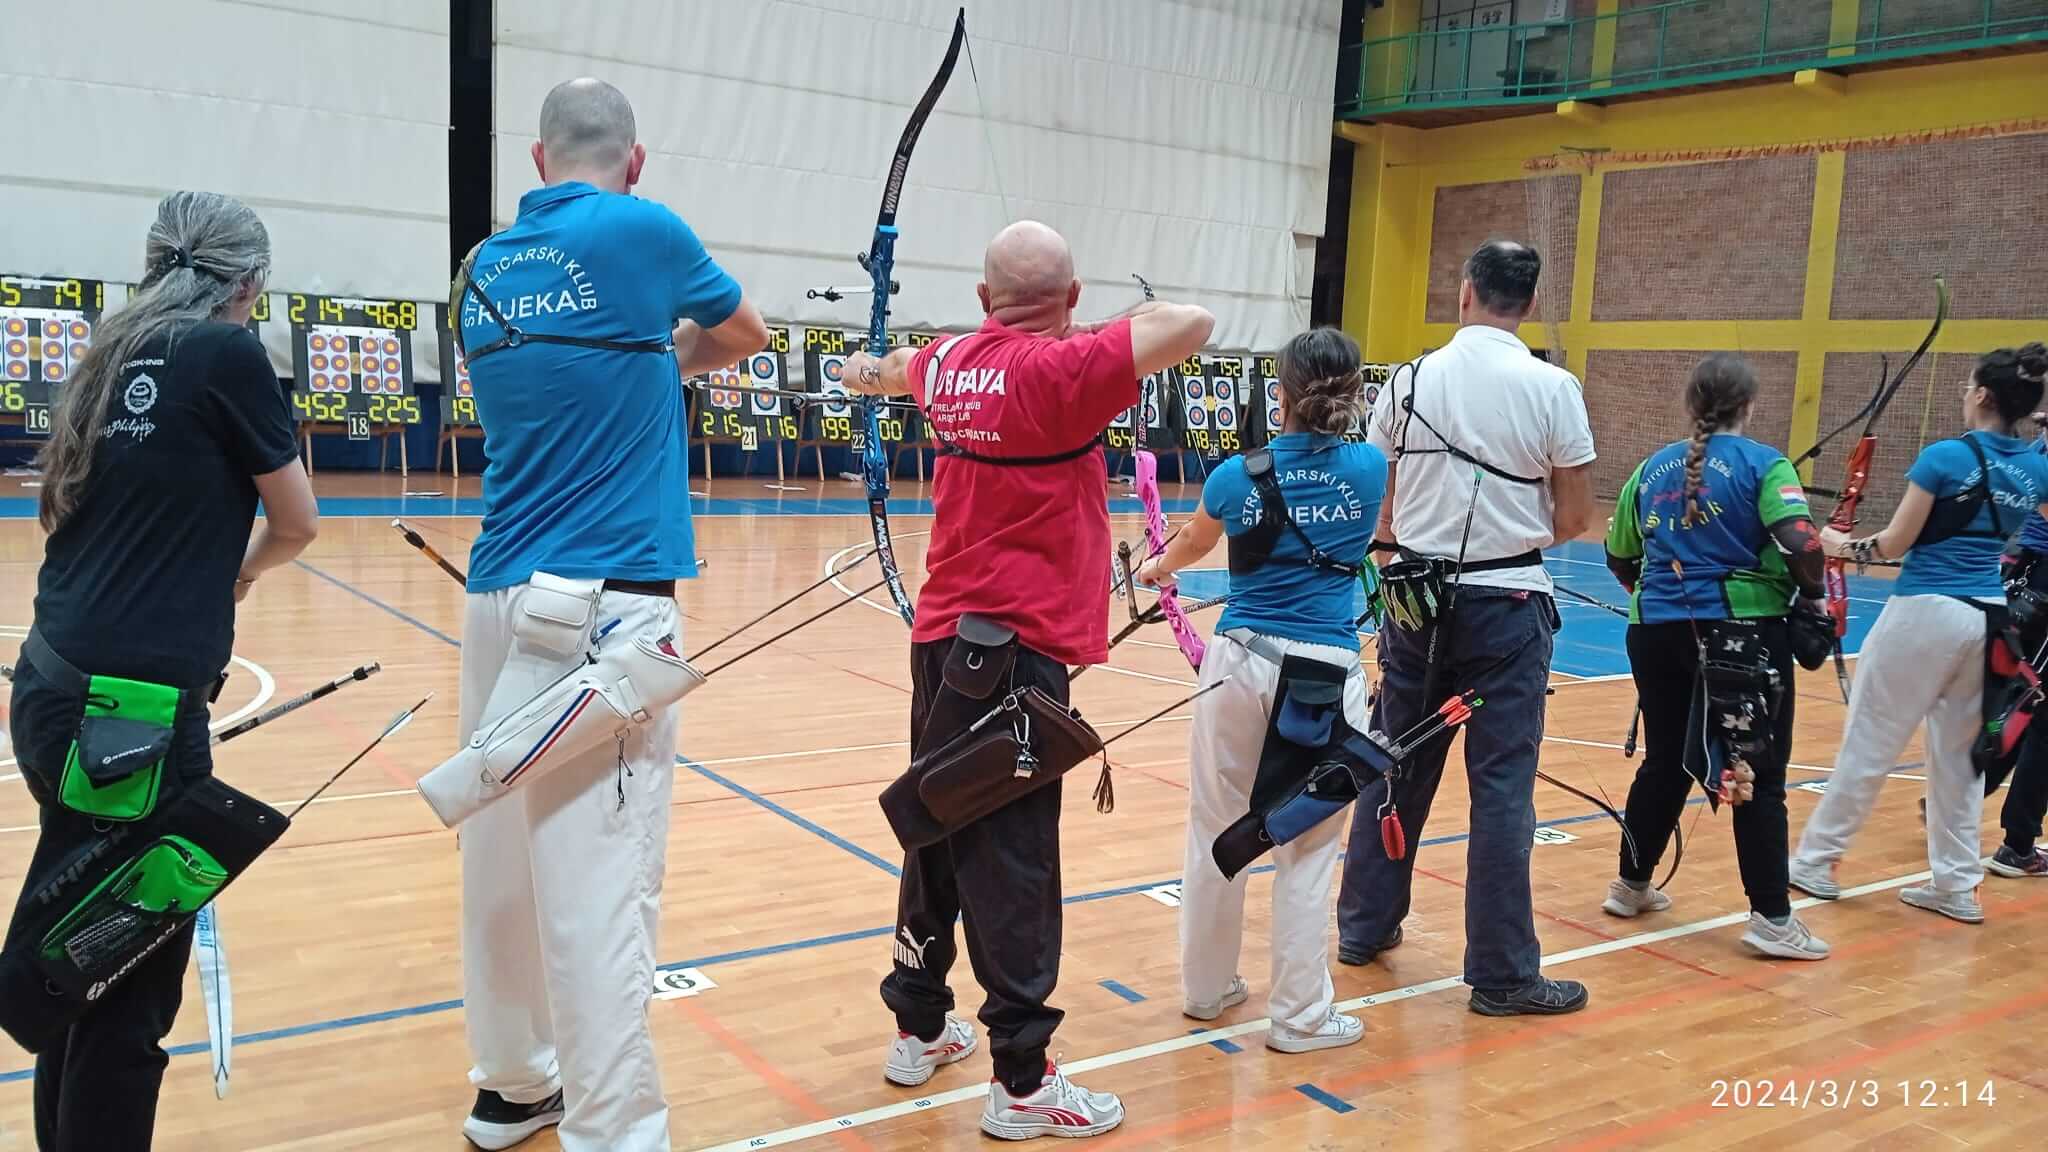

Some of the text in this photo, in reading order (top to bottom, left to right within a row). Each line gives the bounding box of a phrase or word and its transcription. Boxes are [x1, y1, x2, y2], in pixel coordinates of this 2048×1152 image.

[884, 154, 907, 214] WIN&WIN
[564, 259, 597, 310] KLUB
[478, 290, 579, 325] RIJEKA
[28, 408, 49, 429] 16
[292, 393, 347, 420] 452
[369, 396, 421, 424] 225
[351, 417, 369, 436] 18
[703, 411, 742, 437] 215
[821, 417, 851, 440] 199
[1220, 430, 1240, 450] 85
[1337, 481, 1361, 520] KLUB
[749, 1138, 768, 1147] AC
